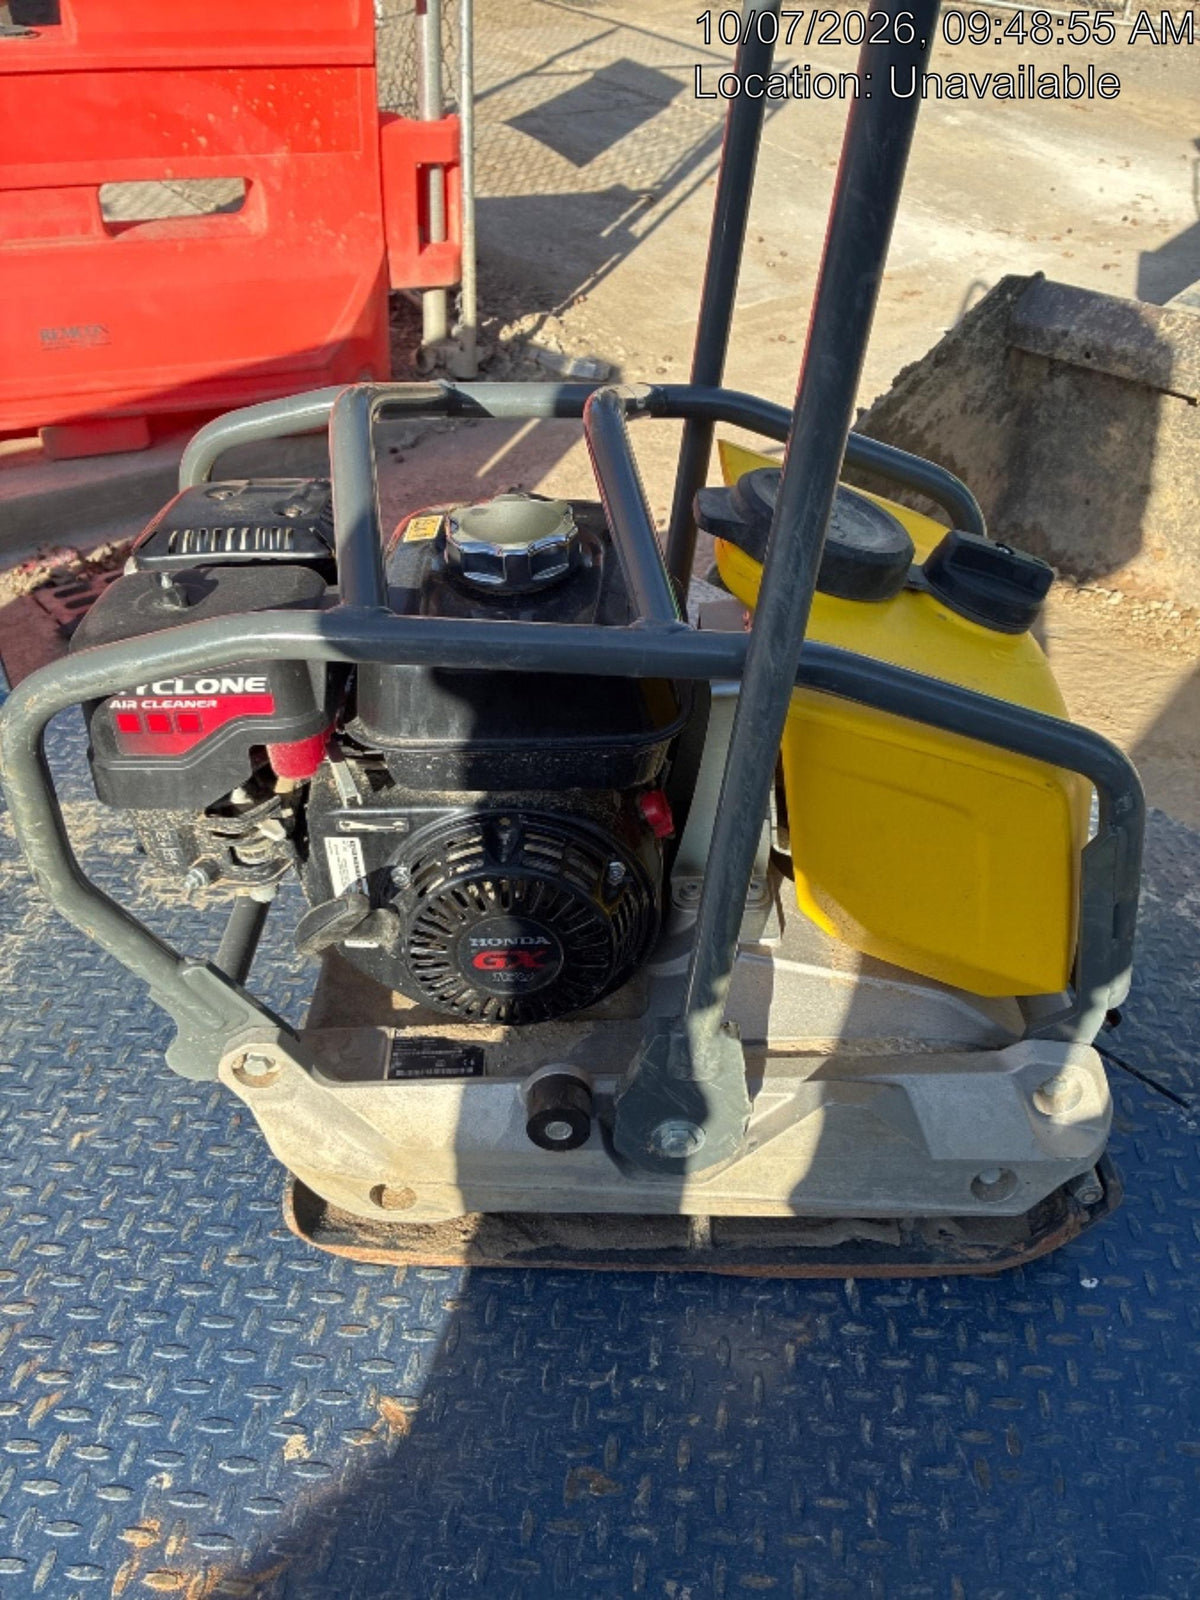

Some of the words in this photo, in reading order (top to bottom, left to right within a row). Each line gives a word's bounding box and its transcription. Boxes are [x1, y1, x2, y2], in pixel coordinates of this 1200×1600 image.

[109, 700, 138, 709] AIR
[141, 699, 218, 709] CLEANER
[469, 936, 551, 947] HONDA
[472, 949, 547, 971] GX
